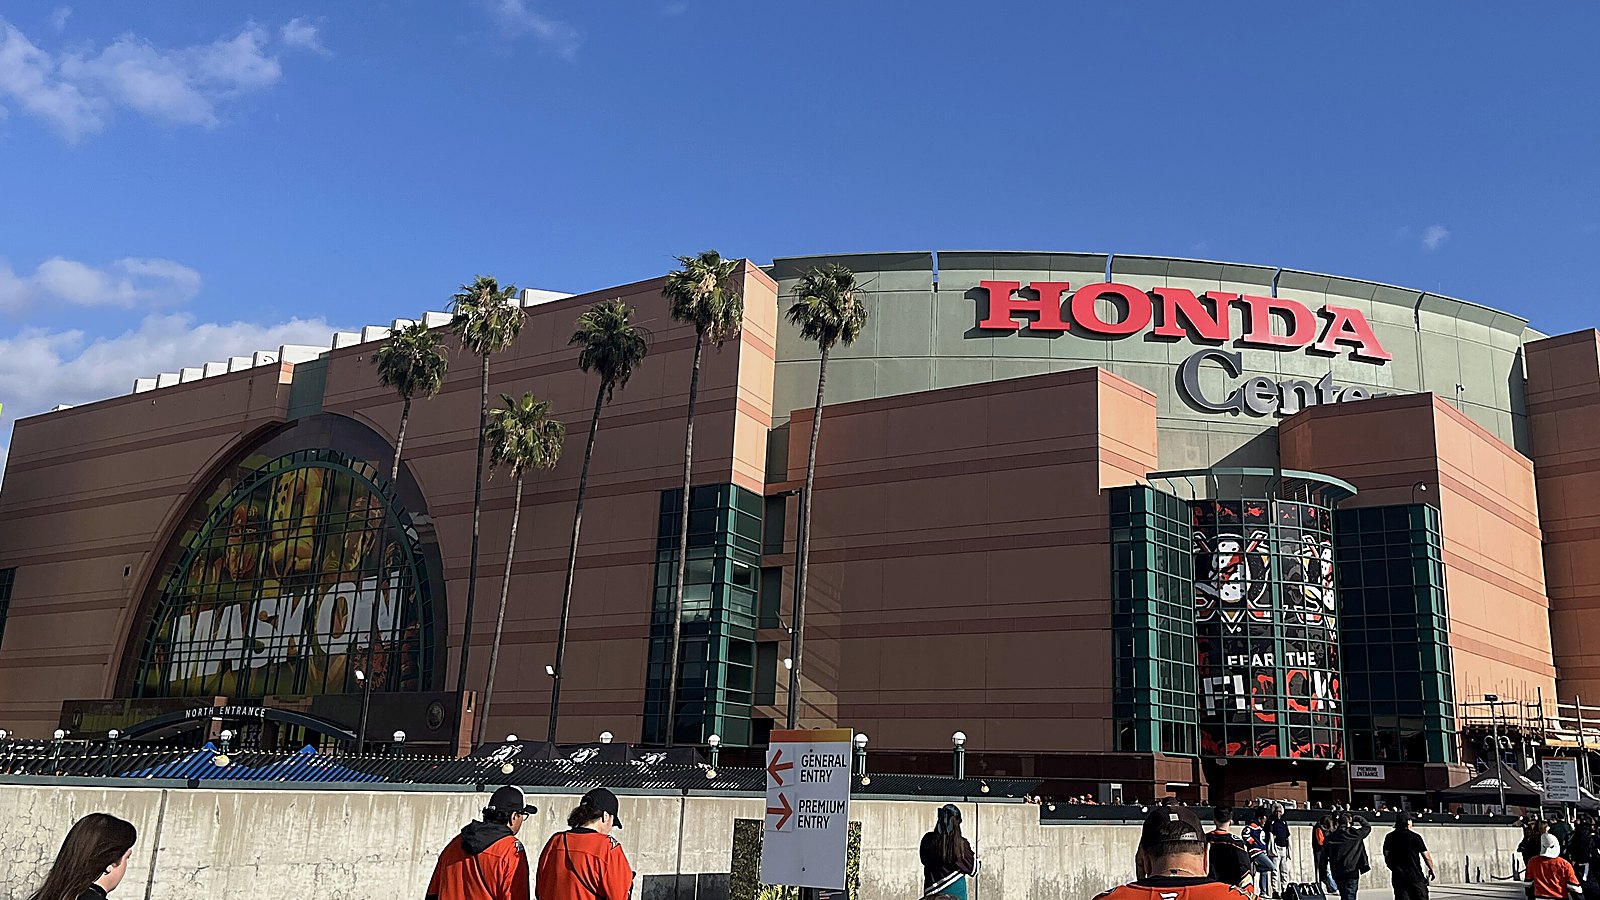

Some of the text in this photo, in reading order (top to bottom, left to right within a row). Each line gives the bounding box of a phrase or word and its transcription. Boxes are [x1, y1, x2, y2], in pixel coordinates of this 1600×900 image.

[979, 280, 1392, 360] HONDA
[1180, 349, 1397, 414] Cent
[169, 588, 315, 682] MASK
[1227, 651, 1317, 669] FEAR THE
[185, 705, 266, 718] NORTH ENTRANCE
[801, 754, 848, 768] GENERAL
[800, 769, 833, 783] ENTRY
[799, 799, 846, 814] PREMIUM
[797, 815, 831, 829] ENTRY
